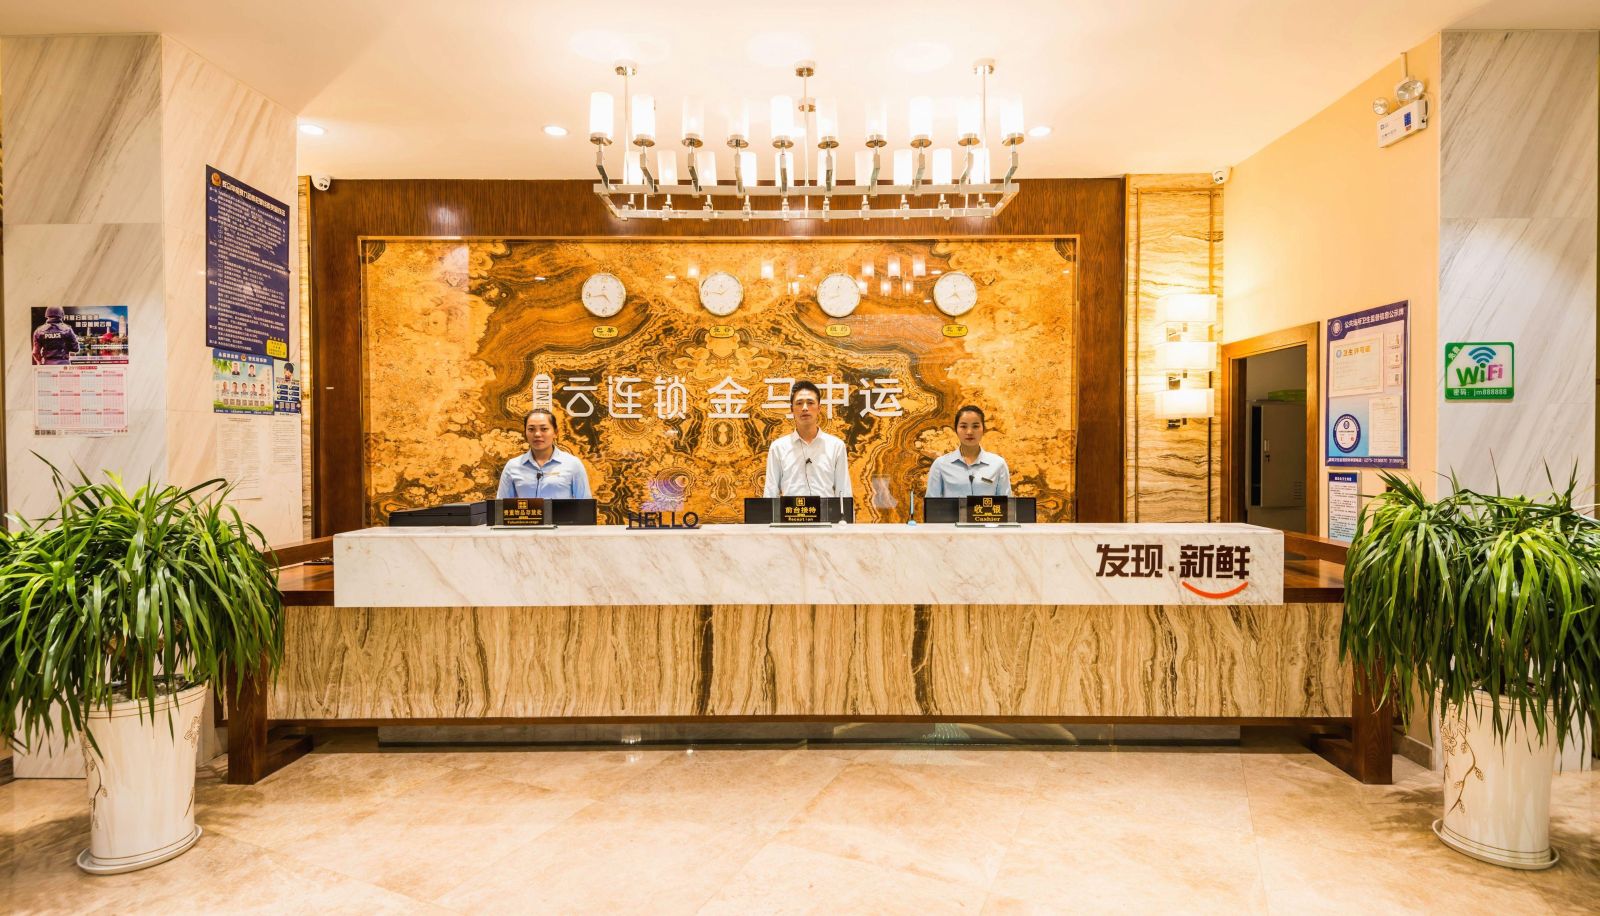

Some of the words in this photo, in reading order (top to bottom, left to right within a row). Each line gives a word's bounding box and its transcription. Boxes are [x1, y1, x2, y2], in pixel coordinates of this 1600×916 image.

[1456, 363, 1503, 386] WiFi
[563, 376, 687, 419] 云连锁
[708, 376, 903, 419] 金马中运
[785, 506, 817, 514] 前台接待
[974, 505, 1001, 514] 收银
[628, 512, 699, 528] HELLO
